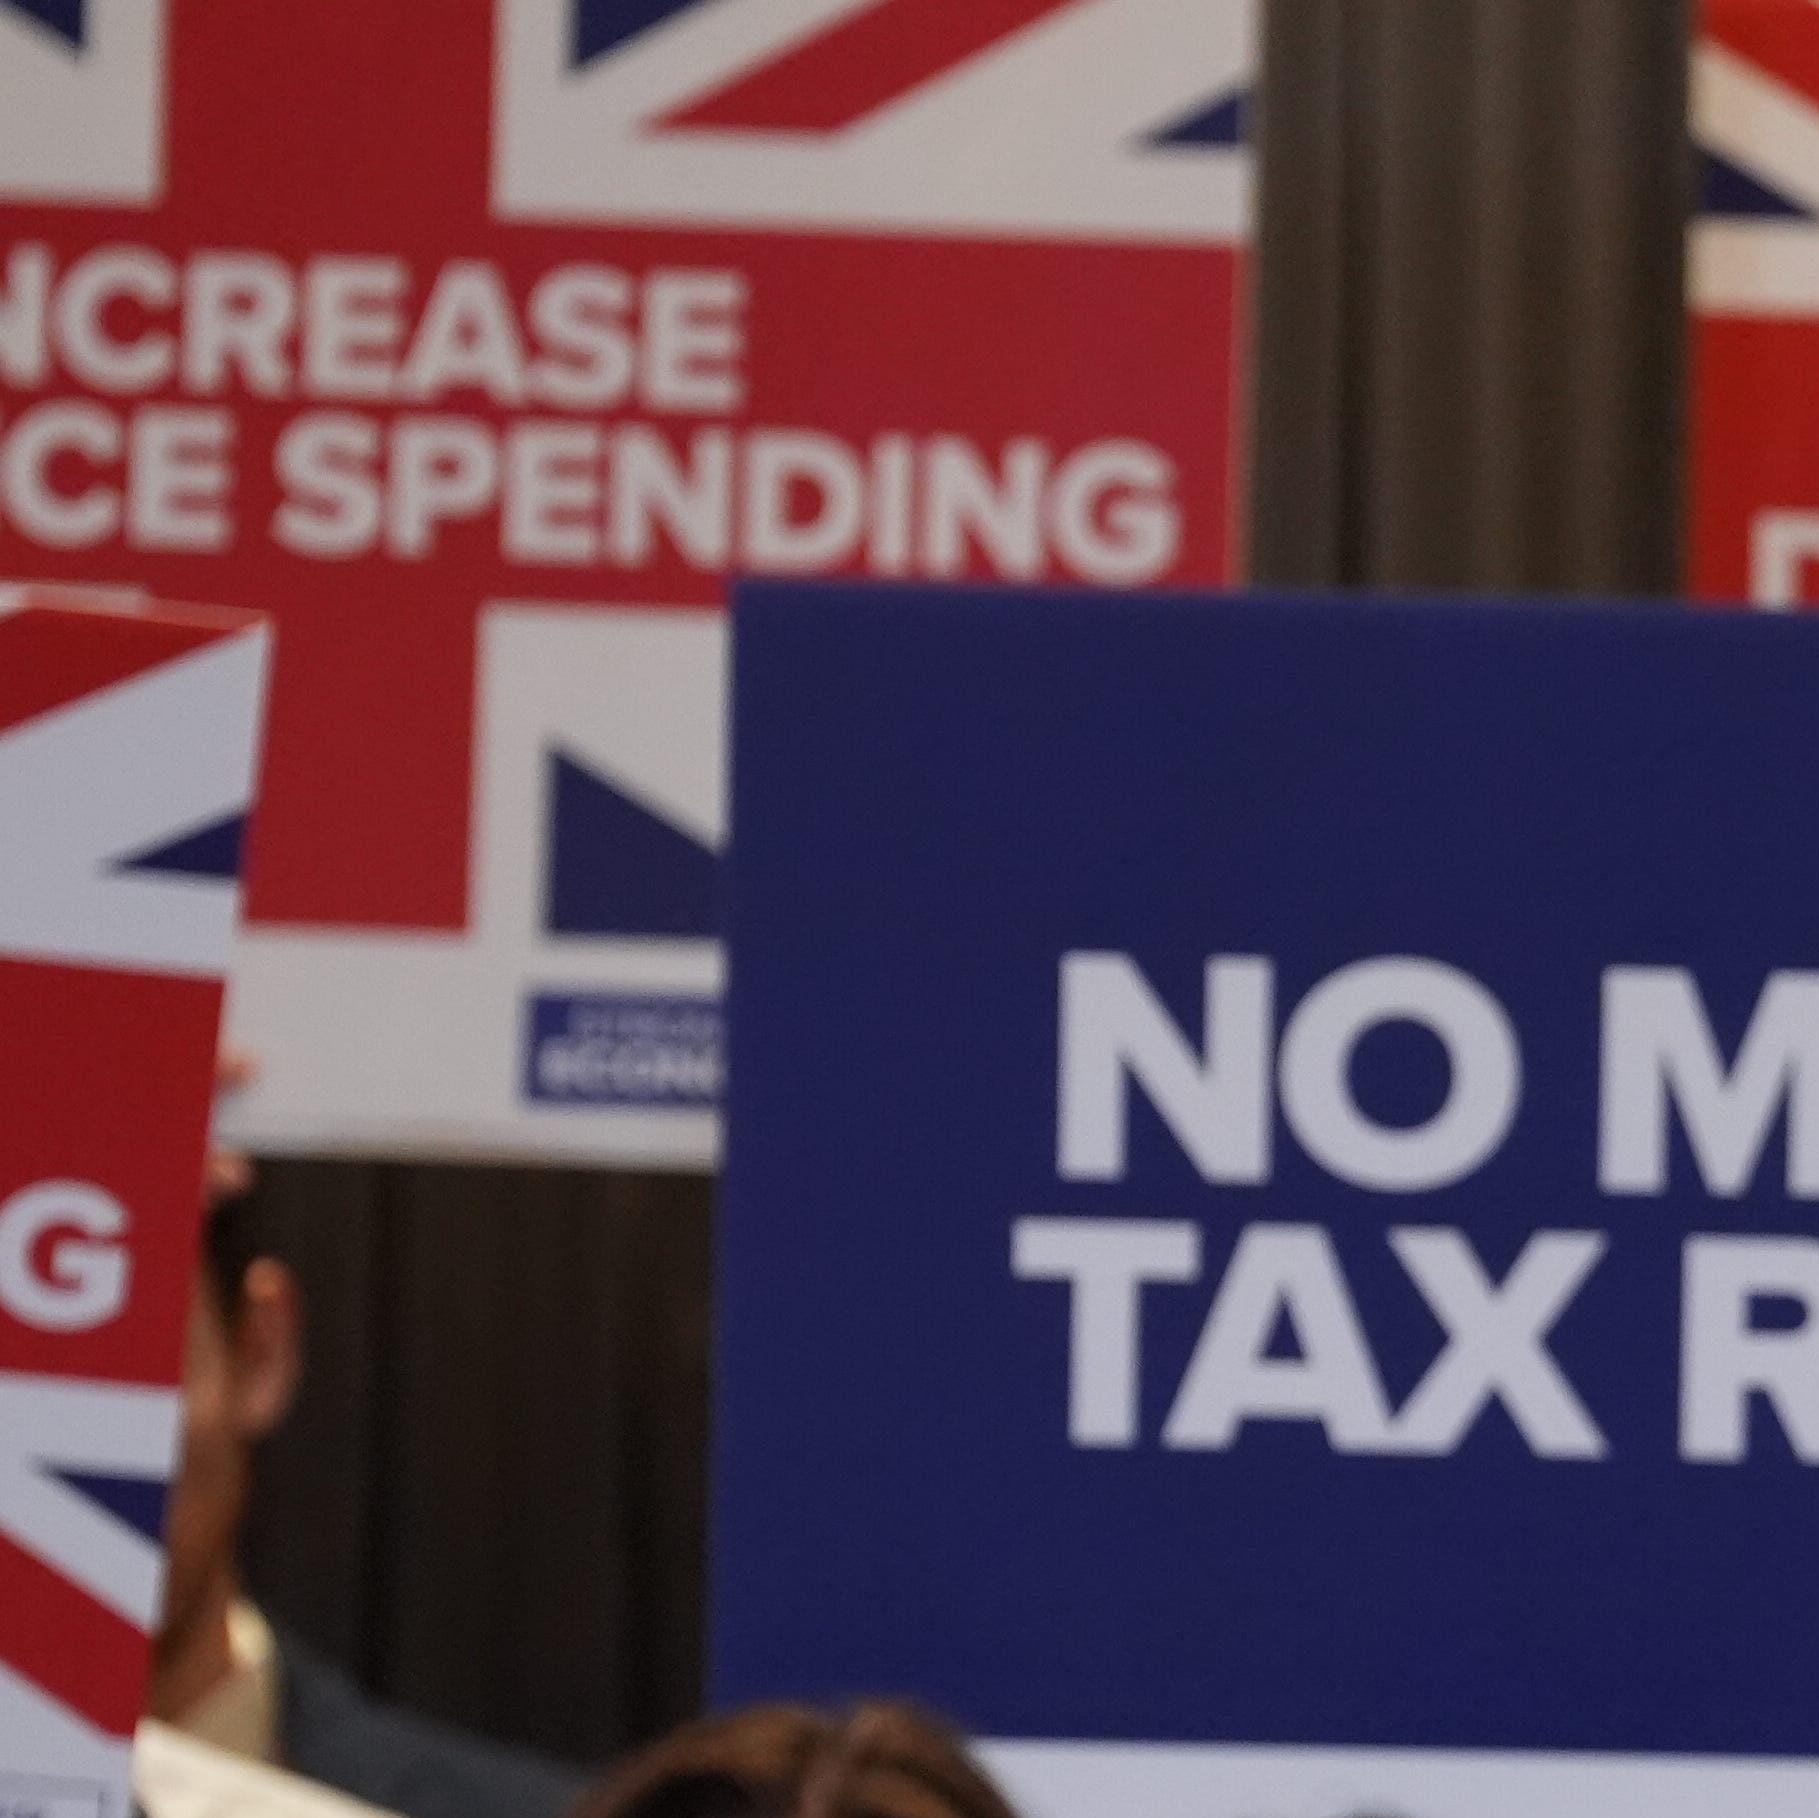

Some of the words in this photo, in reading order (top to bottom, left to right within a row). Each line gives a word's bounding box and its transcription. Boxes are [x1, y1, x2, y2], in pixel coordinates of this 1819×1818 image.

[272, 415, 1182, 586] SPENDING
[1056, 950, 1522, 1193] NO
[1010, 1218, 1610, 1460] TAX
